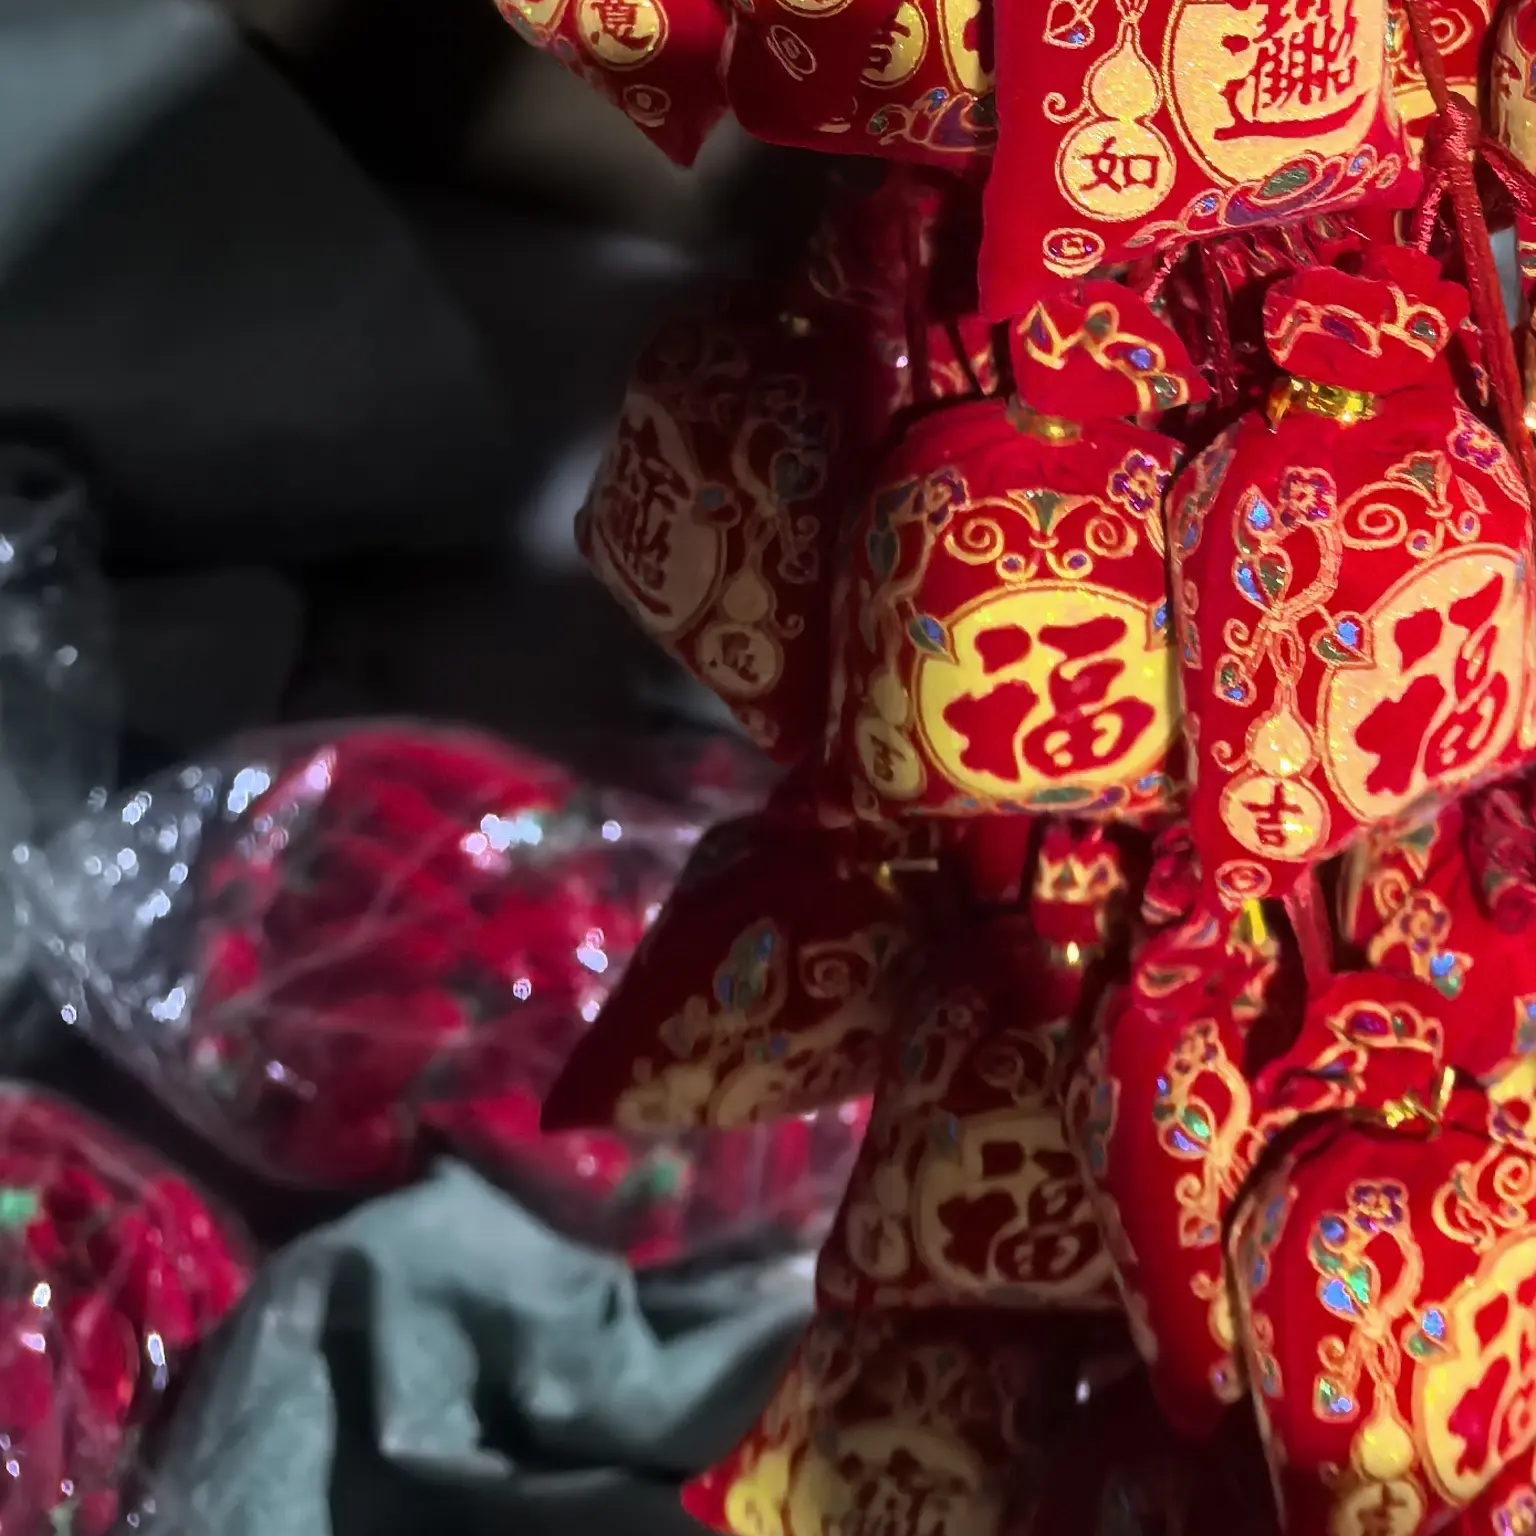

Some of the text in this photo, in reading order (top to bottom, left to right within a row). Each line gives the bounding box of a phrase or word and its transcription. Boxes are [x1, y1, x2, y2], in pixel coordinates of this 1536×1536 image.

[1078, 139, 1160, 193] 如
[943, 616, 1155, 782] 福
[1355, 571, 1509, 799] 福
[1243, 782, 1313, 846] 吉
